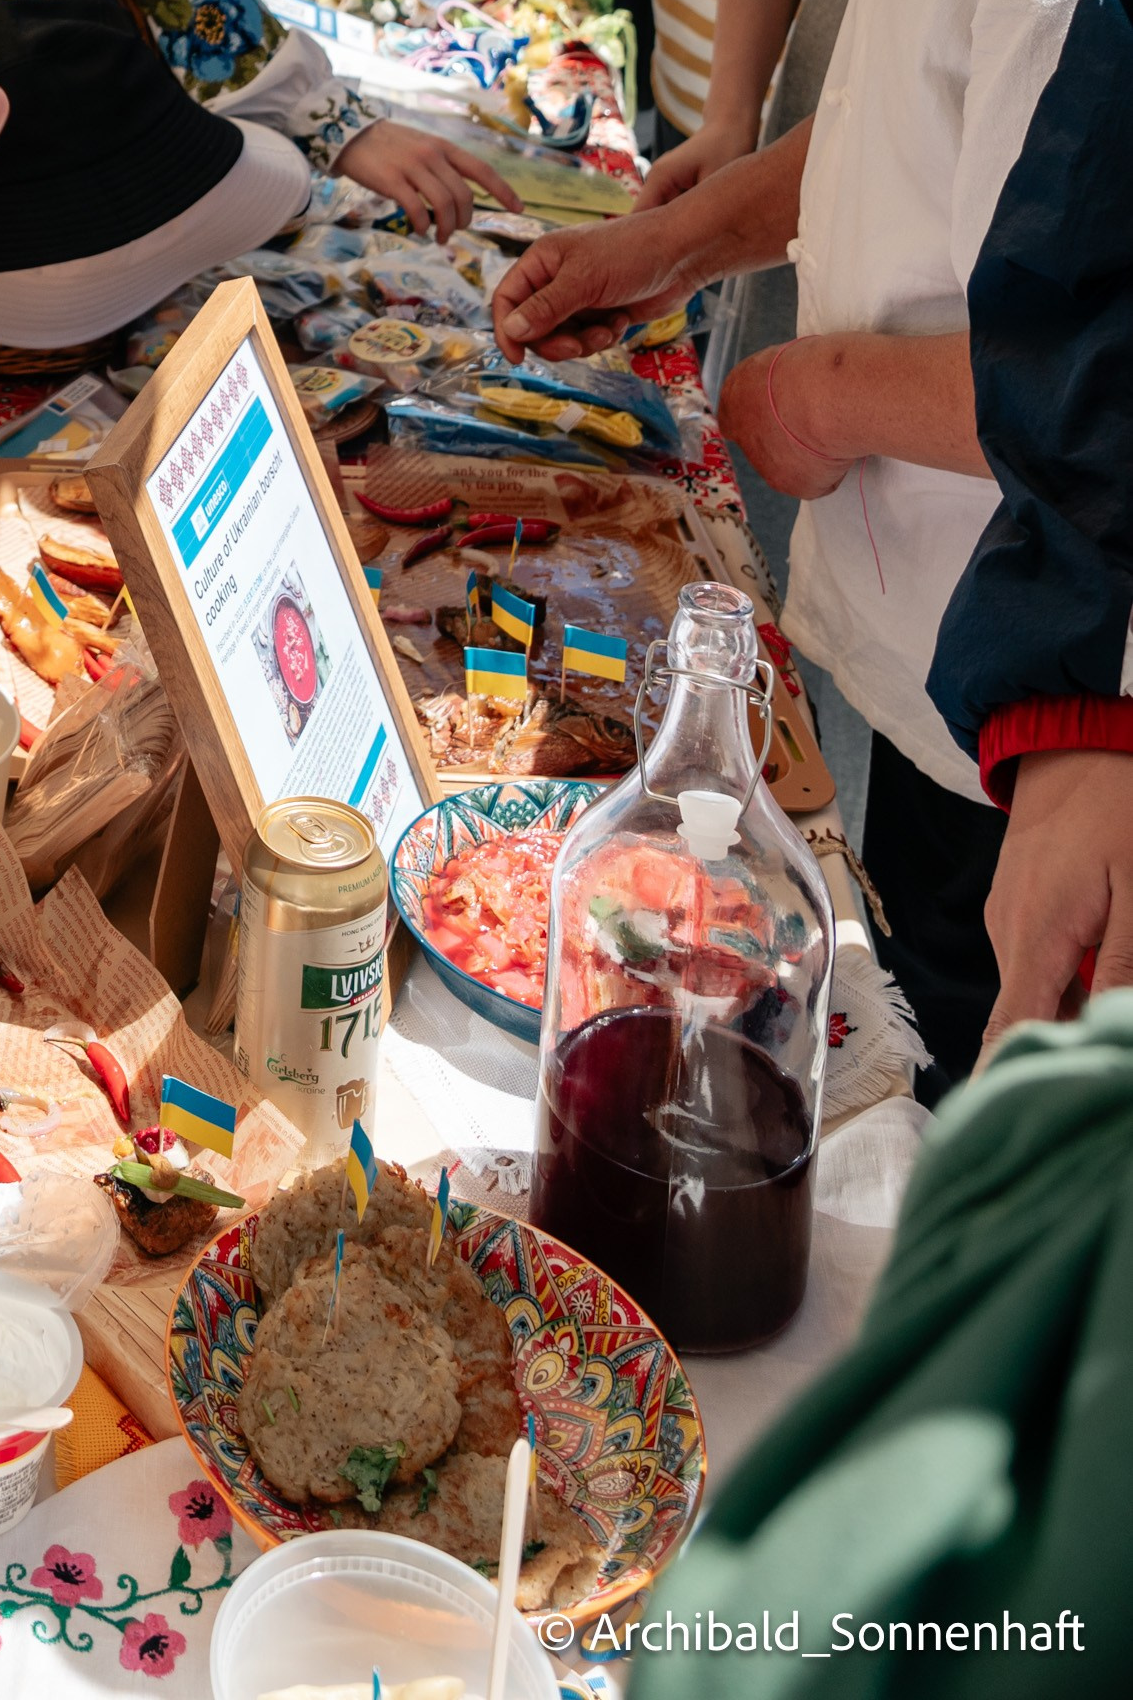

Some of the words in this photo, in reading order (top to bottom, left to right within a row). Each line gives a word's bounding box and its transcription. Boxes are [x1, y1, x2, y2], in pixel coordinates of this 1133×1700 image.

[480, 468, 504, 479] you
[506, 465, 526, 478] for
[528, 466, 549, 478] the
[205, 480, 227, 517] unesco
[194, 553, 224, 599] Culture
[223, 534, 233, 557] of
[229, 490, 262, 544] Ukrainian
[258, 450, 283, 495] borscht
[206, 575, 238, 626] cooking
[338, 877, 370, 895] PREMIUM
[50, 901, 82, 944] concentrated
[108, 924, 123, 942] and
[341, 927, 360, 937] HONG
[45, 938, 63, 960] Middle
[60, 958, 73, 974] East
[67, 945, 82, 966] South
[100, 936, 116, 953] daily
[132, 953, 153, 975] belongs
[319, 990, 383, 1060] 1715
[212, 1054, 224, 1071] ratio
[266, 1057, 319, 1086] Carlsberg
[203, 1058, 223, 1095] According
